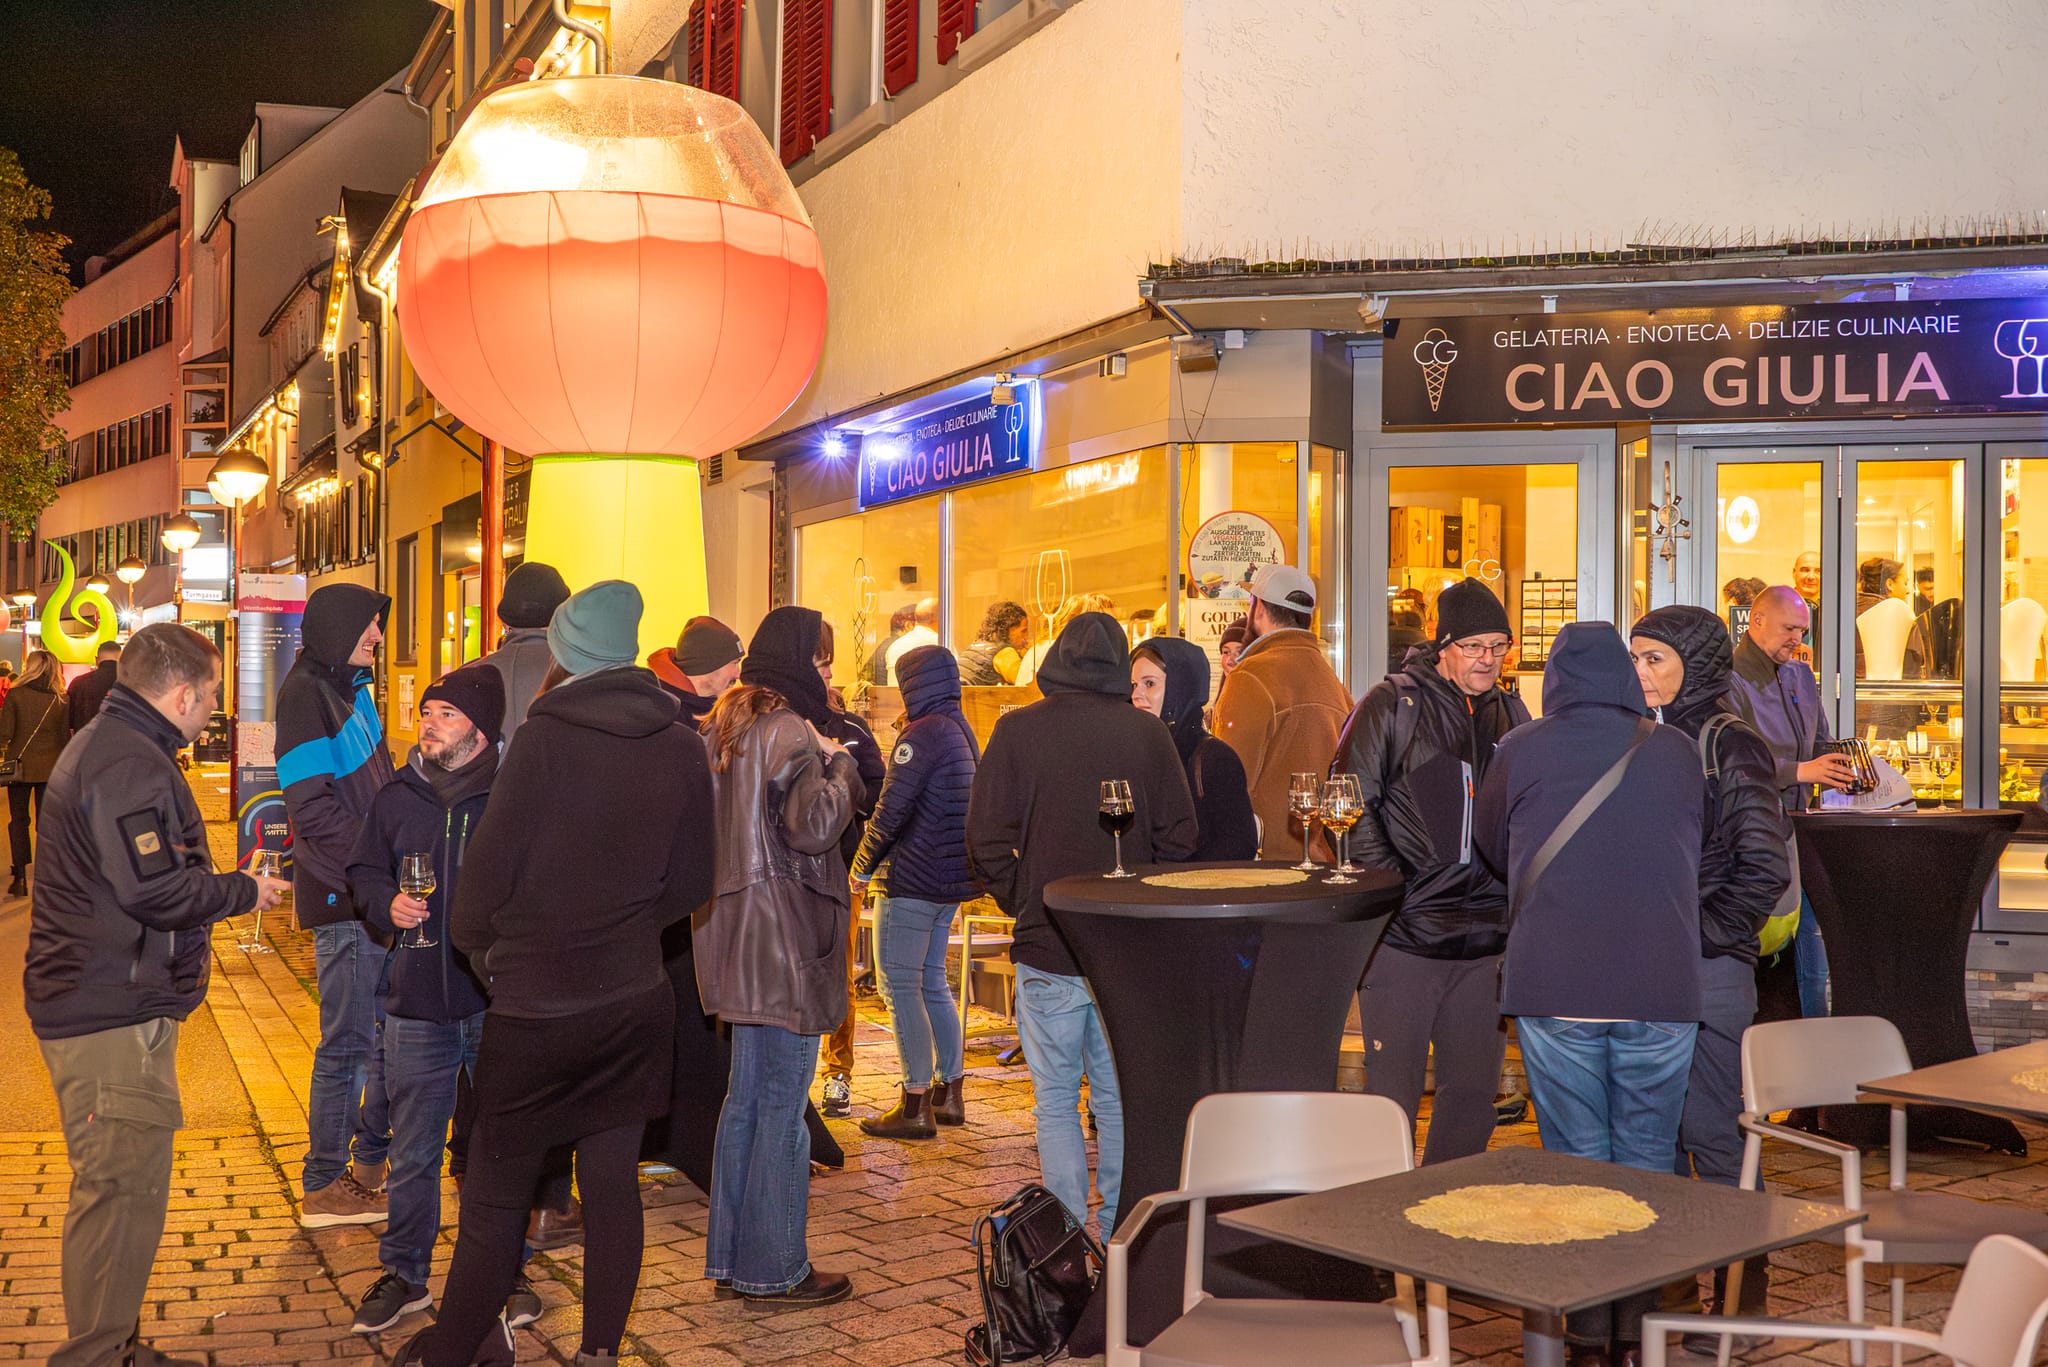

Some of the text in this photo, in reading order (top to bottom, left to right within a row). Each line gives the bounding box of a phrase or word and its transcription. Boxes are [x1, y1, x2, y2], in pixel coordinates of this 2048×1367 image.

[1493, 315, 1960, 348] GELATERIA ENOTECA DELIZIE CULINARIE
[1413, 340, 1458, 365] CG
[1505, 351, 1950, 412] CIAO GIULIA
[916, 423, 942, 441] ENOTECA
[944, 417, 965, 433] DELIZIE
[966, 404, 998, 427] CULINARIE
[887, 432, 994, 493] CIAO GIULIA
